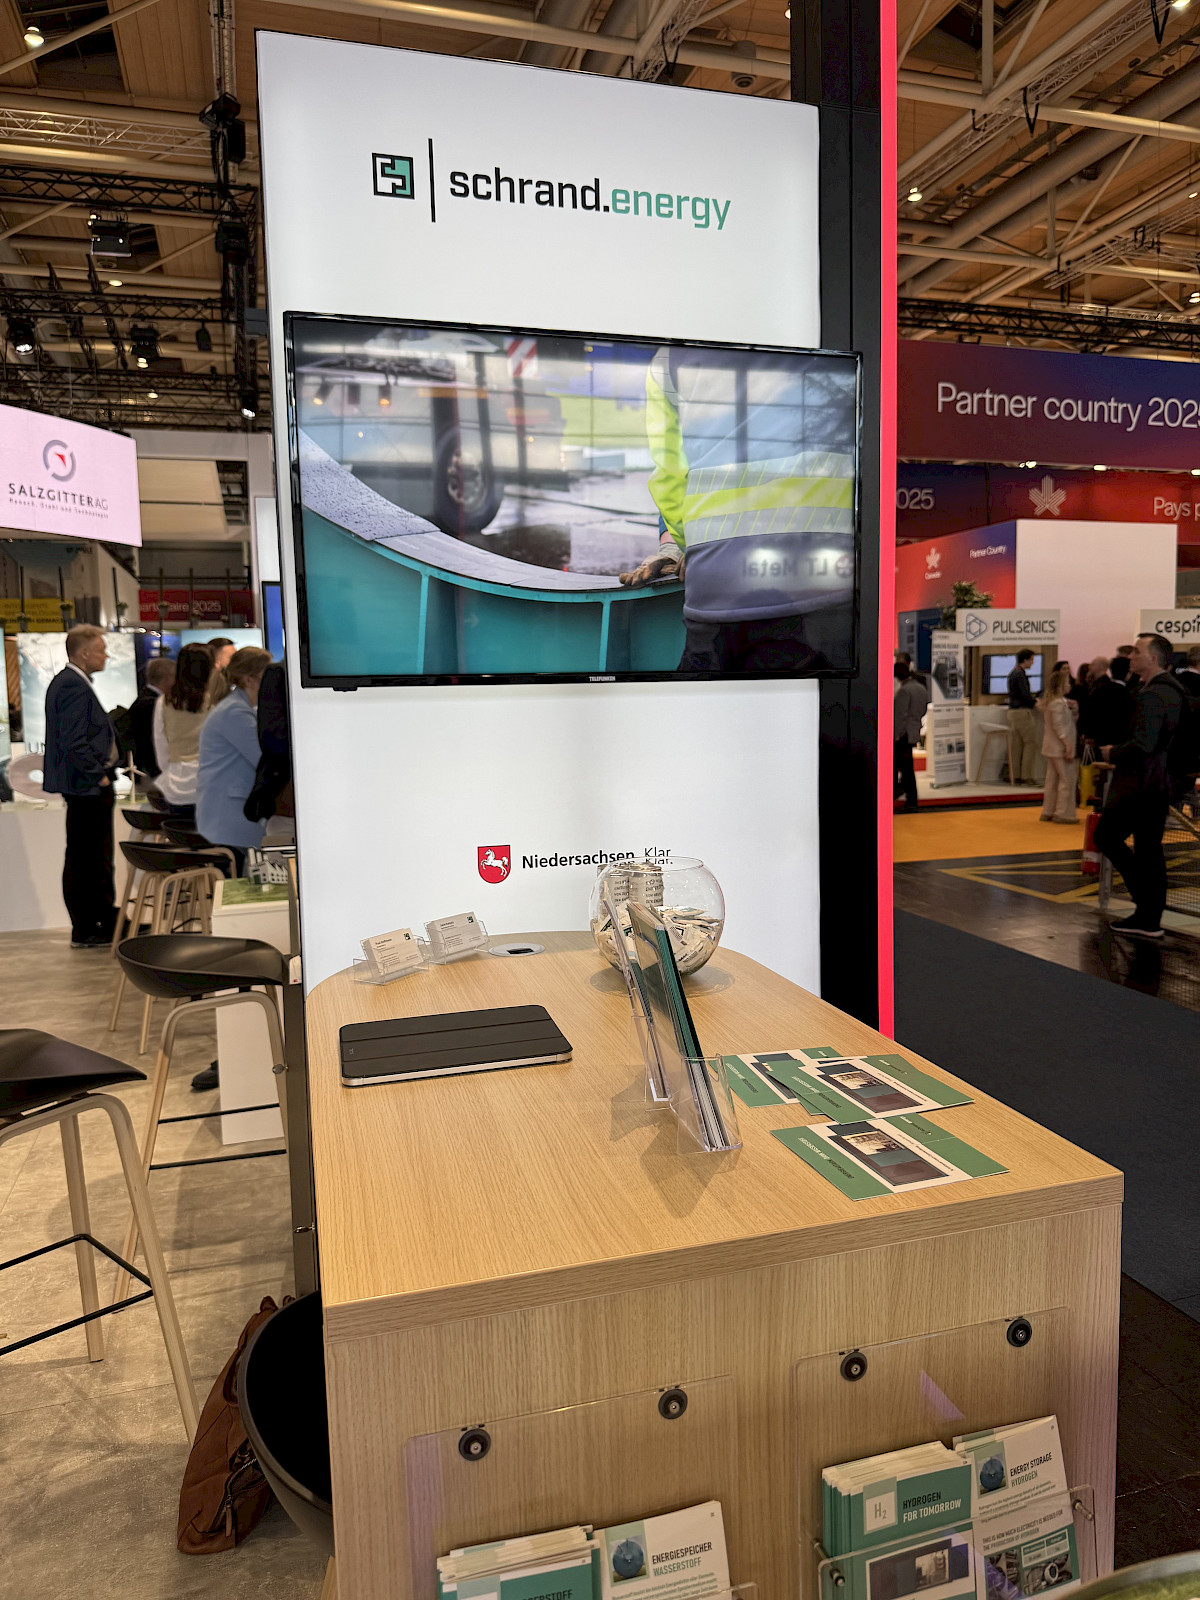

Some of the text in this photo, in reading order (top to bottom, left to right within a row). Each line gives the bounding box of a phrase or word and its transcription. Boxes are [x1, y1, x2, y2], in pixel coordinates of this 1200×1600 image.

[450, 167, 731, 230] schrand.energy
[937, 382, 1200, 432] Partner country 202
[1153, 496, 1191, 521] Pays
[522, 850, 635, 869] Niedersachsen
[1010, 1452, 1053, 1477] ENERGY STORAGE
[1011, 1470, 1039, 1488] HYDROGEN
[902, 1490, 942, 1510] HYDROGEN
[903, 1510, 918, 1523] FOR
[919, 1498, 962, 1518] TOMORROW
[652, 1541, 713, 1565] ENERGIESPEICHER
[653, 1556, 702, 1577] WASSERSTOFF
